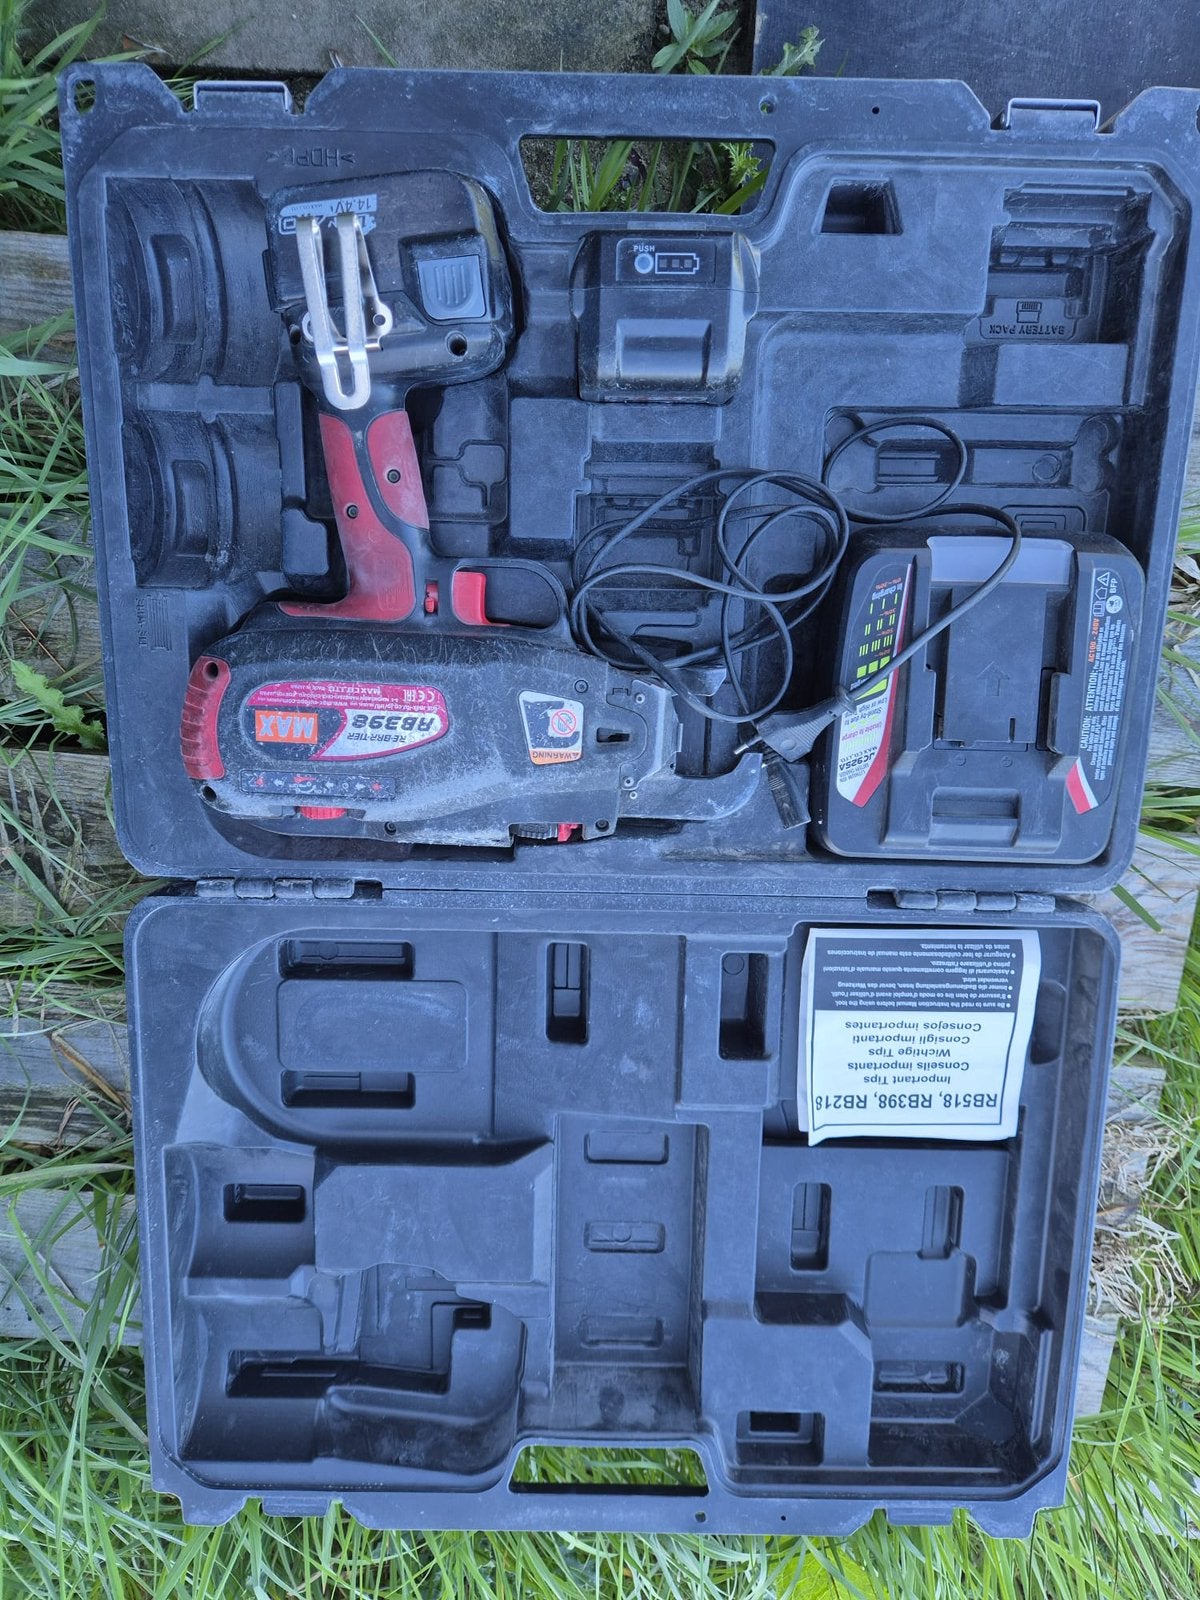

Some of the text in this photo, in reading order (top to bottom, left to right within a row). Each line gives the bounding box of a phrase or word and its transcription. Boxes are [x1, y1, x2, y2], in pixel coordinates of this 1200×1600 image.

[989, 324, 1064, 335] BATTERY PACK
[1110, 578, 1118, 593] BFP
[872, 586, 896, 600] charging
[1088, 641, 1097, 662] AC100
[1085, 670, 1099, 711] ATTENTION:
[860, 704, 870, 712] High
[860, 707, 881, 719] Stand-by
[352, 714, 434, 732] RB398
[850, 715, 859, 723] due
[259, 715, 314, 738] MAX
[865, 722, 882, 734] Unable
[1080, 716, 1091, 748] CAUTION:
[842, 731, 858, 741] charge
[864, 746, 877, 754] MAX
[839, 752, 875, 770] JC925A
[845, 1021, 982, 1032] Consejos importantes
[852, 1034, 970, 1044] Consigli importanti
[868, 1047, 951, 1057] Wichtige Tips
[848, 1061, 969, 1071] Conseils importants
[863, 1074, 951, 1085] Important Tips
[815, 1091, 998, 1110] RB518, RB398, RB218
